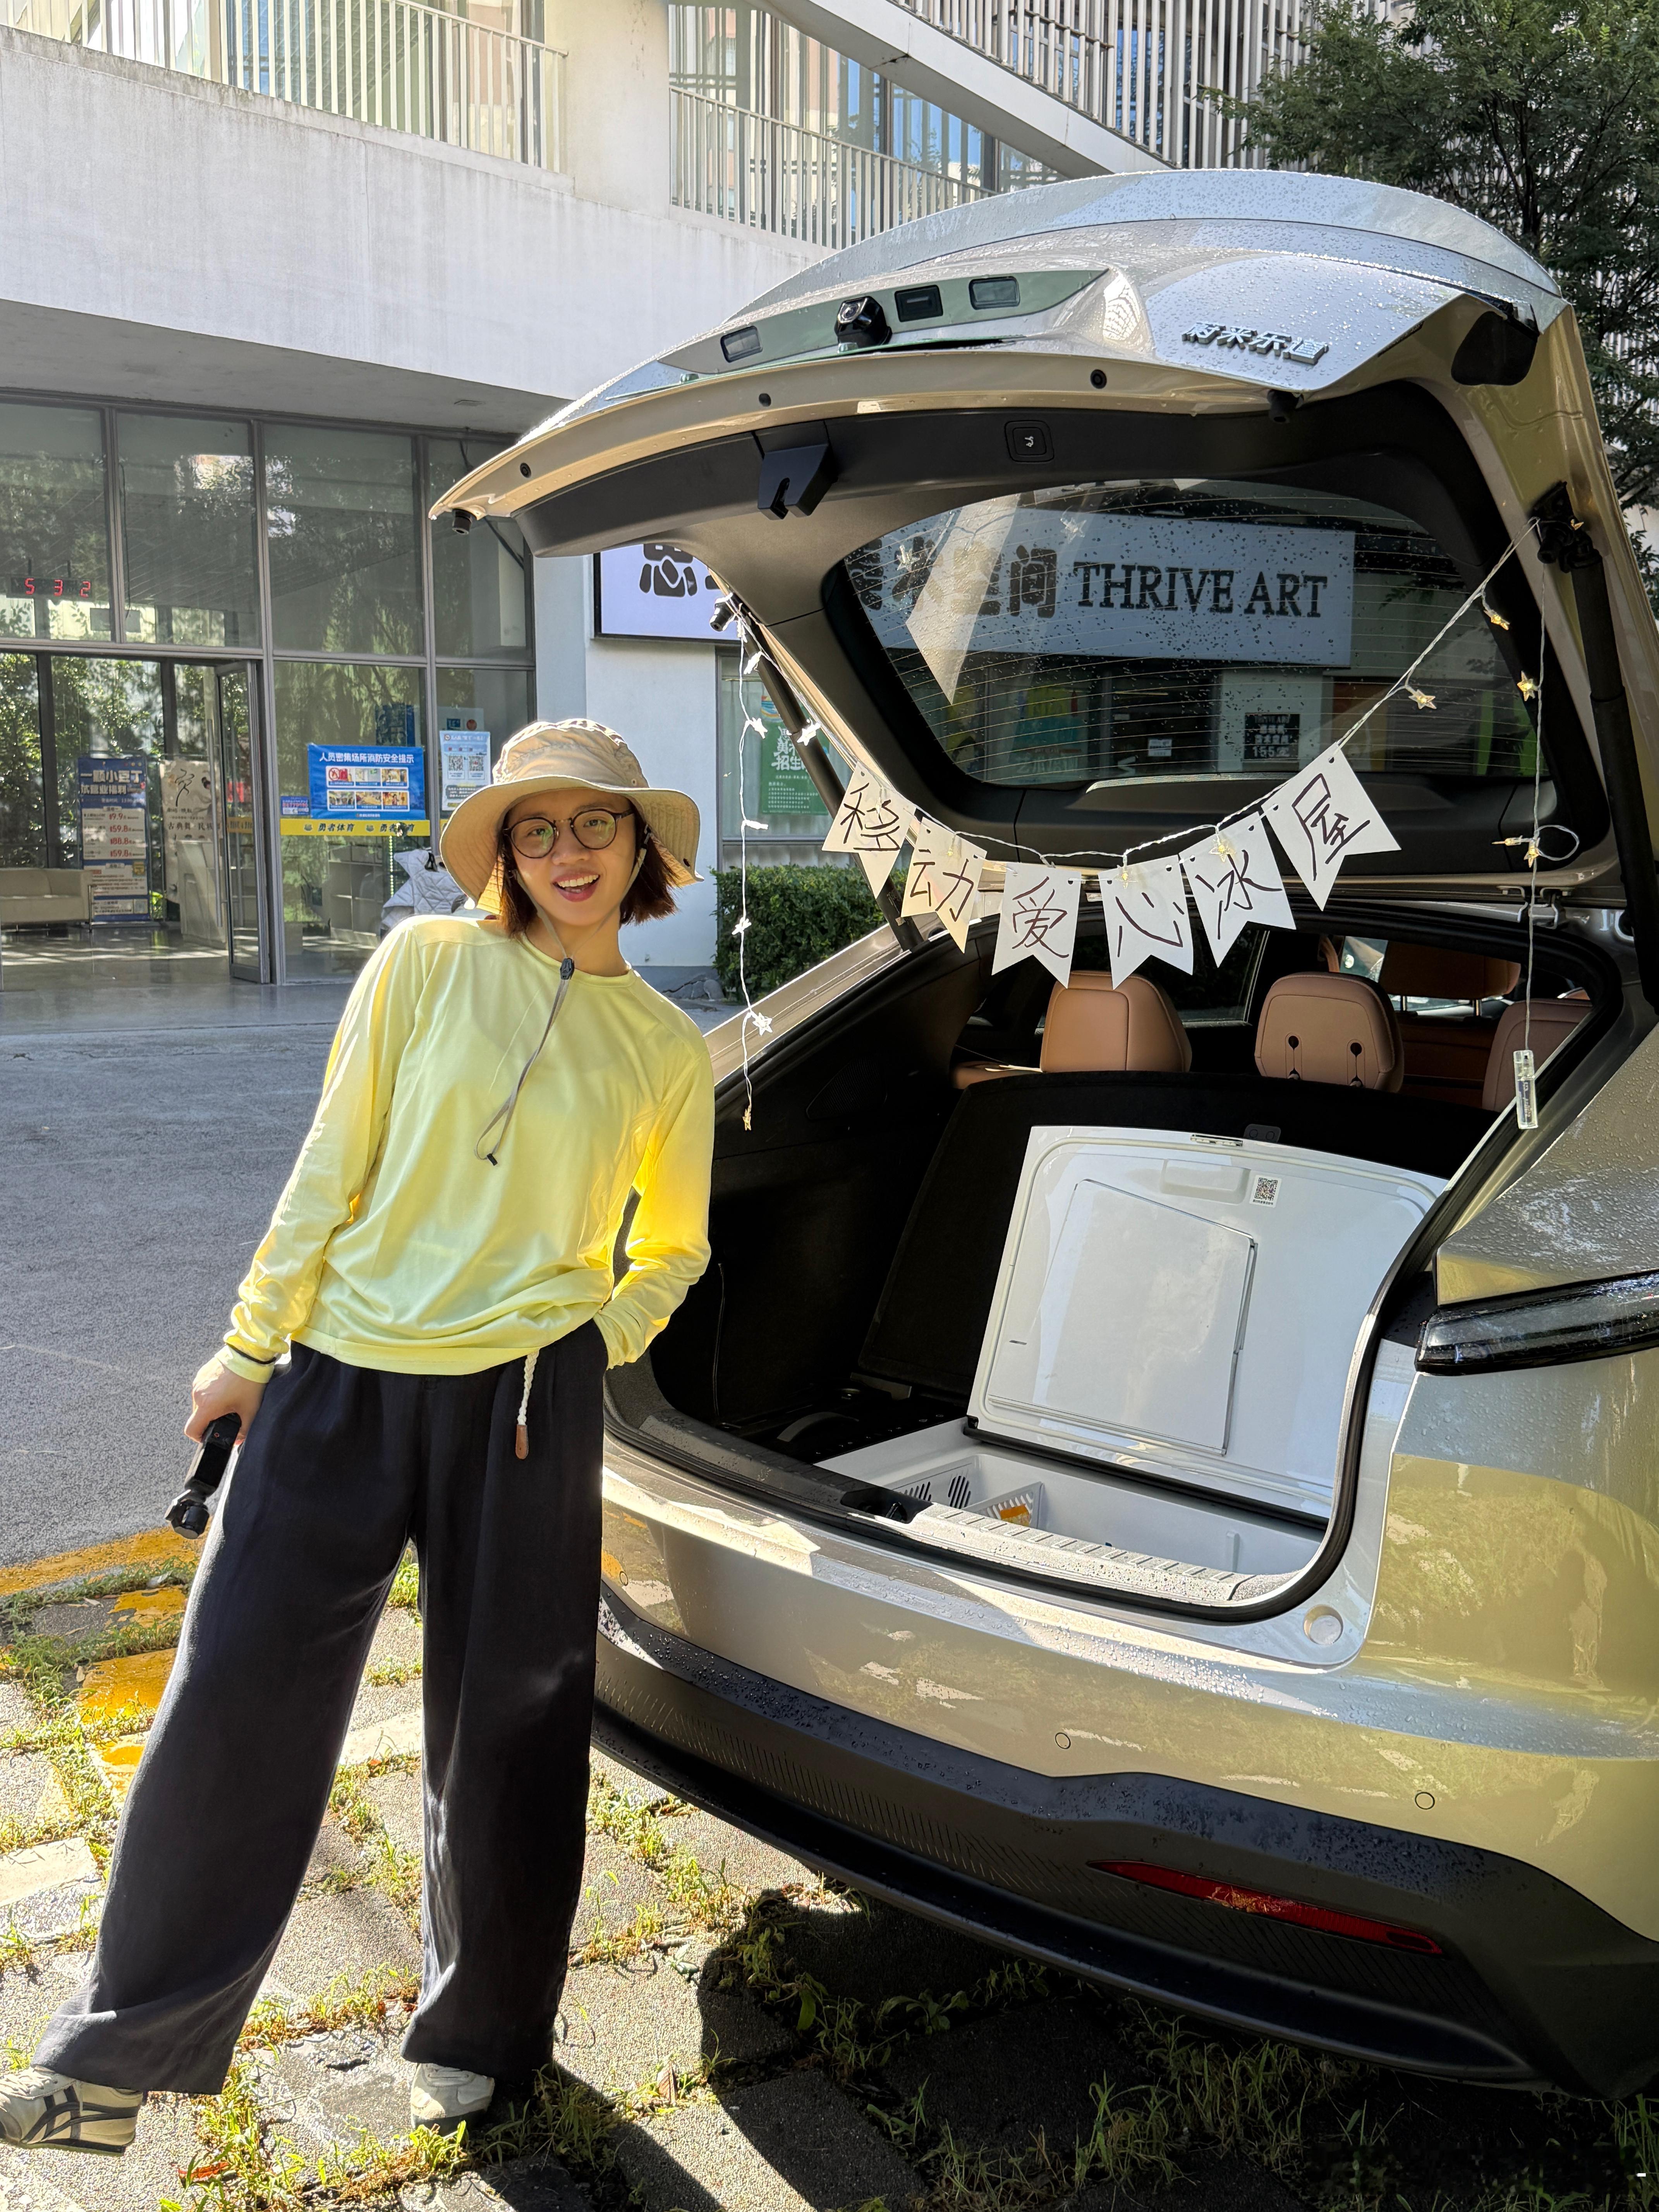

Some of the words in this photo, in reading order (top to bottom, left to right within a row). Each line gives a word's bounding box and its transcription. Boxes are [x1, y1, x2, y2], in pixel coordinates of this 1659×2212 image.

[1182, 321, 1329, 365] 蔚来乐道
[640, 544, 720, 598] 思
[24, 577, 35, 595] 5
[53, 579, 64, 597] 3
[80, 580, 91, 598] 2
[1073, 561, 1234, 614] THRIVE
[1244, 572, 1327, 618] ART
[319, 752, 414, 764] 人员密集场所消防安全提示
[771, 755, 805, 771] 招生
[318, 823, 355, 832] 勇者体育
[380, 823, 415, 832] 勇者育
